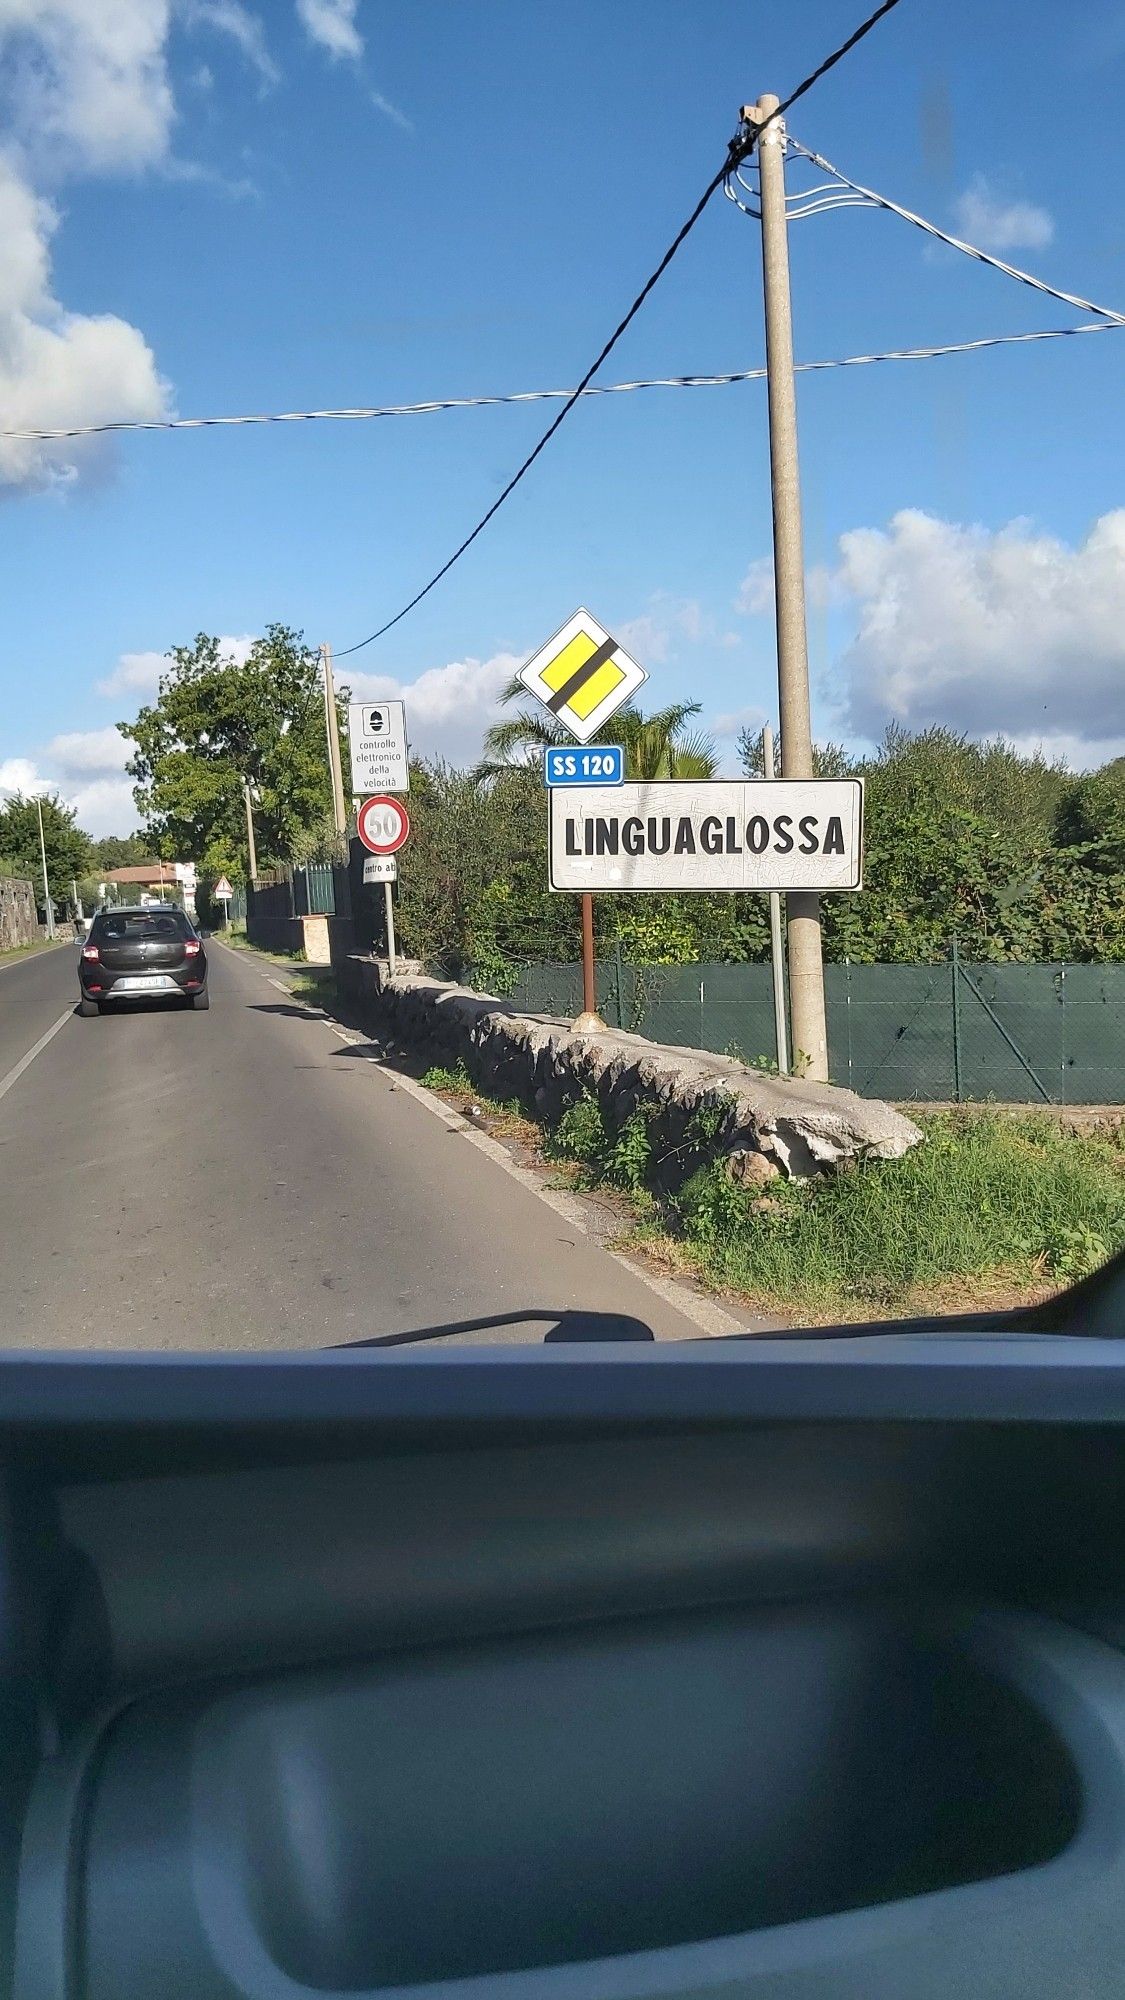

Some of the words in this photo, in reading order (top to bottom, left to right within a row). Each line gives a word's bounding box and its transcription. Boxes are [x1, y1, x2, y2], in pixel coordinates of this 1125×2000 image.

[359, 739, 396, 750] controllo
[356, 752, 401, 763] elettronico
[368, 765, 390, 775] della
[553, 756, 576, 776] SS
[582, 755, 615, 776] 120
[363, 777, 397, 788] velocità
[369, 812, 397, 839] 50
[565, 815, 845, 856] LINGUAGLOSSA
